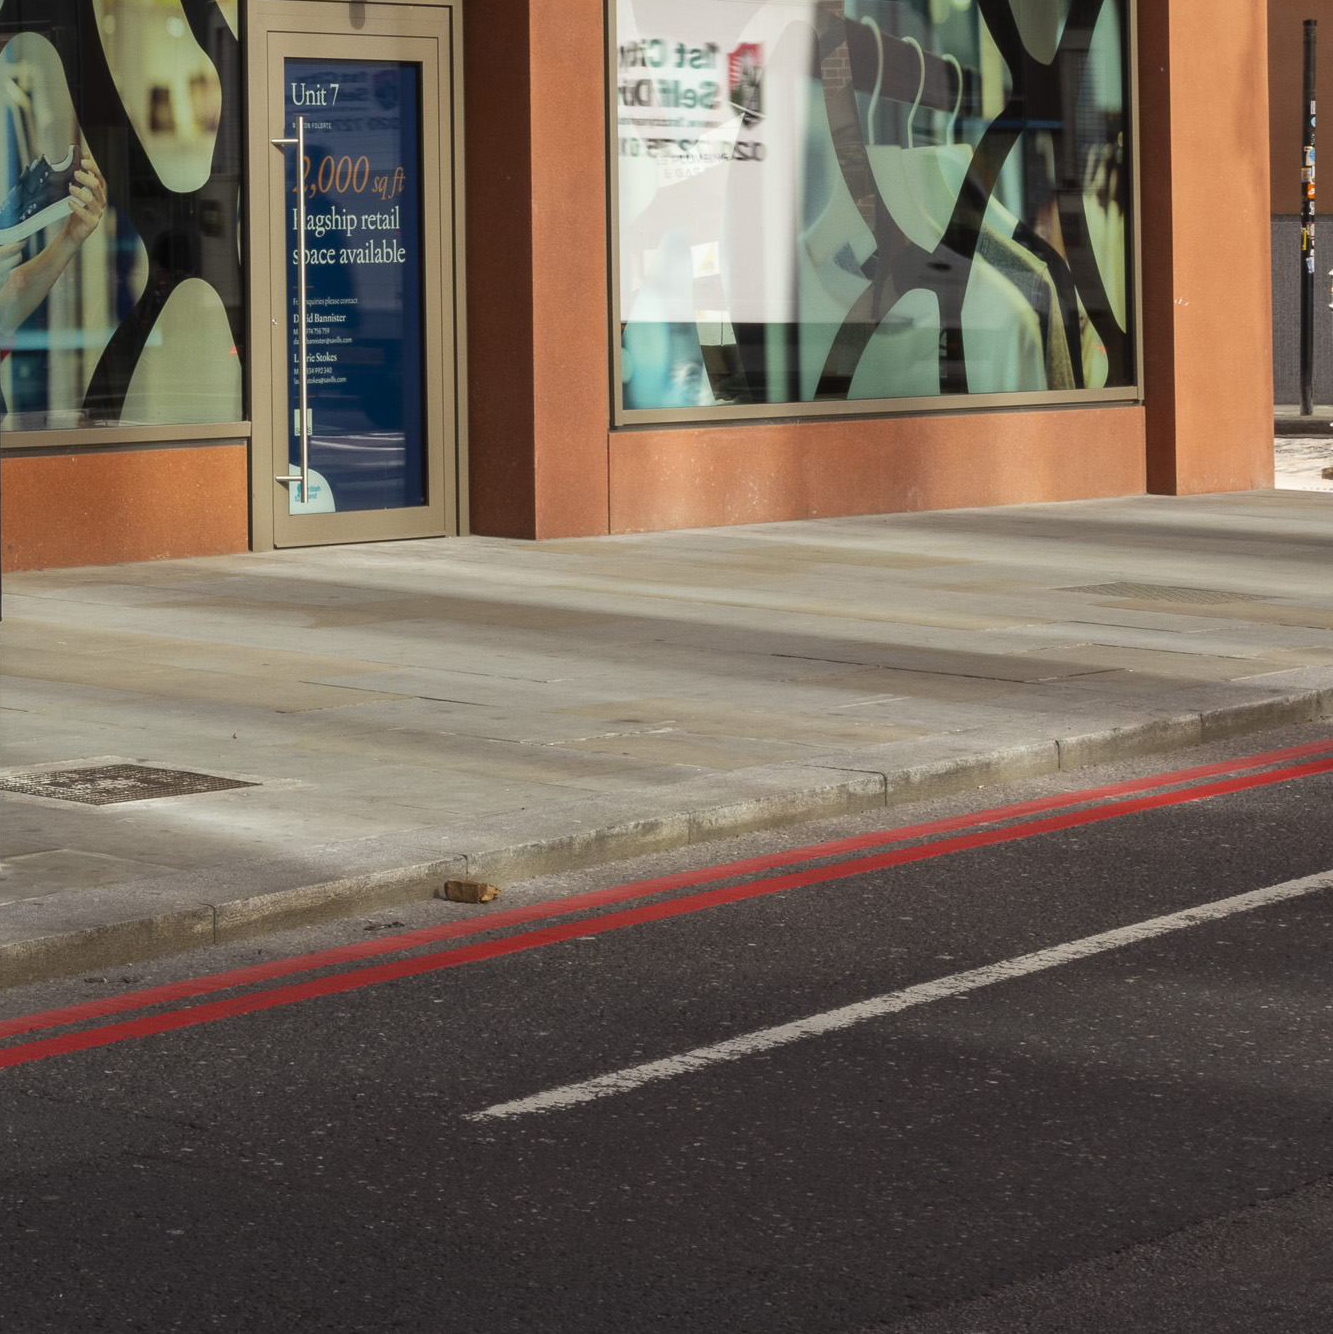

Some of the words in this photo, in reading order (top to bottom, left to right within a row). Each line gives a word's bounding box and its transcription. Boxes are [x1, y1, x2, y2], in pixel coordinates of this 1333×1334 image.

[291, 83, 327, 106] Unit
[330, 83, 339, 106] 7
[372, 174, 388, 200] sq
[388, 166, 405, 199] ft
[293, 206, 357, 237] Fagship
[361, 205, 400, 229] retail
[339, 239, 406, 264] available
[293, 313, 313, 323] Did
[314, 313, 346, 323] Bannister
[294, 353, 315, 363] Lrie
[316, 352, 337, 362] Stokes
